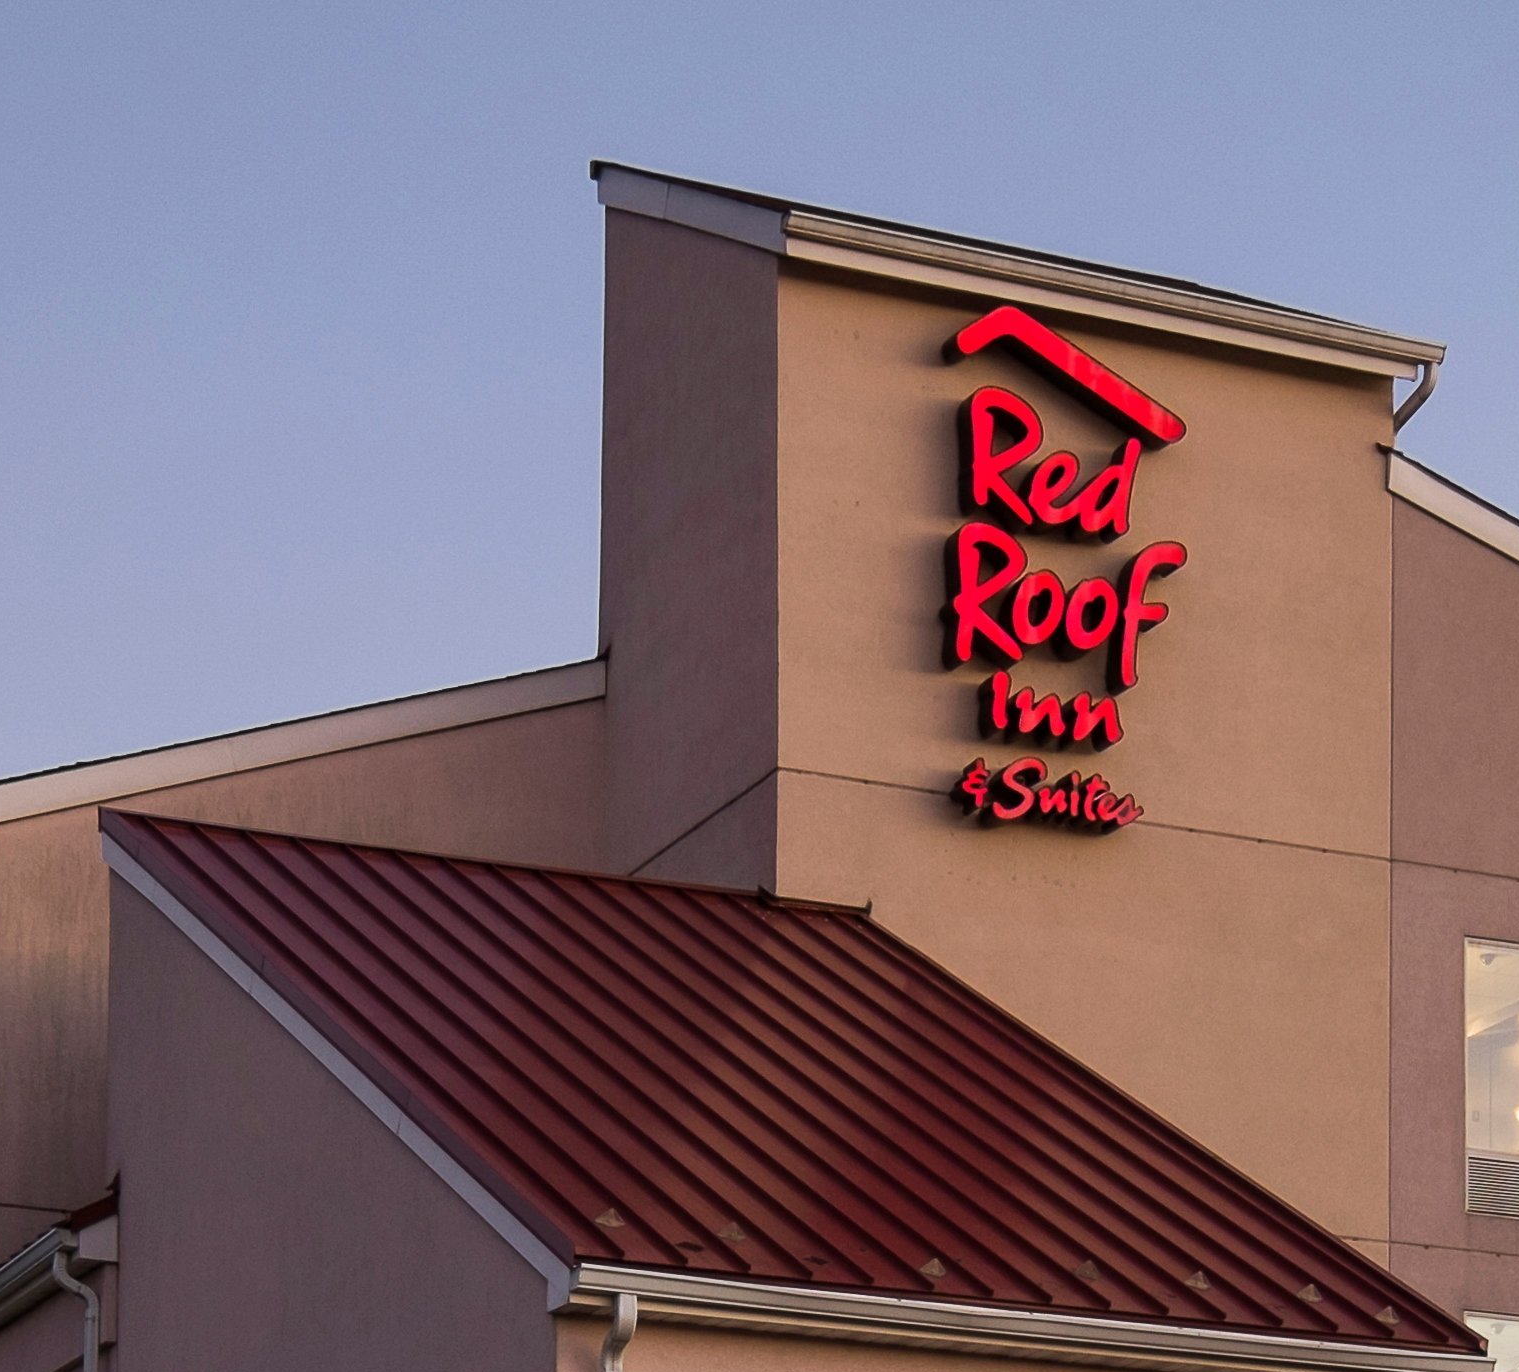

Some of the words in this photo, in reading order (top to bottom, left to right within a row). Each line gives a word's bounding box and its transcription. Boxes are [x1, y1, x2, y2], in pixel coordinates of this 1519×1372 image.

[968, 386, 1141, 536] Red
[954, 523, 1186, 687] Roof
[990, 670, 1123, 745] Inn
